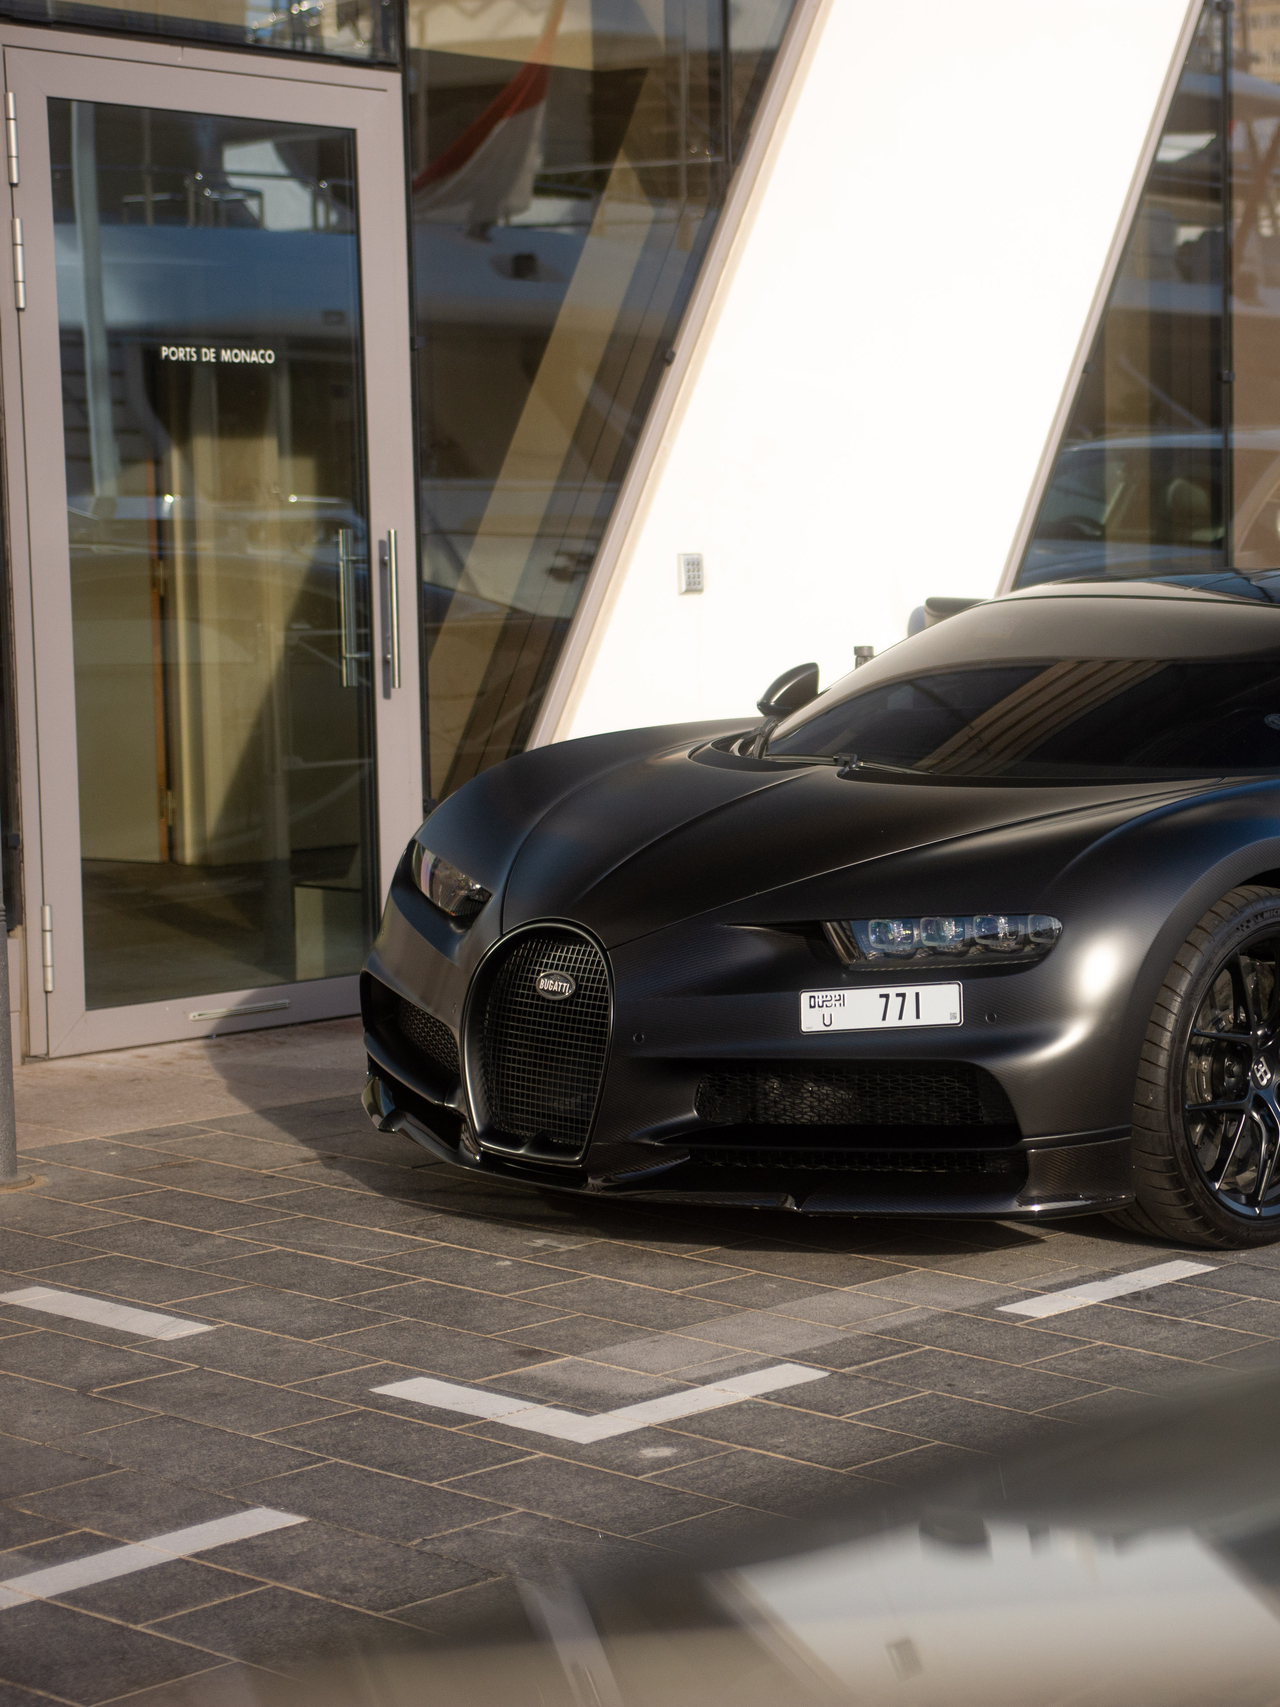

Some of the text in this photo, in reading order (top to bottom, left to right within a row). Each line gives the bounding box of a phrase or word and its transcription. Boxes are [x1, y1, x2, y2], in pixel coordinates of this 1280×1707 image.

[161, 345, 275, 364] PORTS DE MONACO
[539, 978, 570, 993] BUGATTI
[809, 991, 921, 1021] DUBAI 771
[822, 1013, 833, 1027] U
